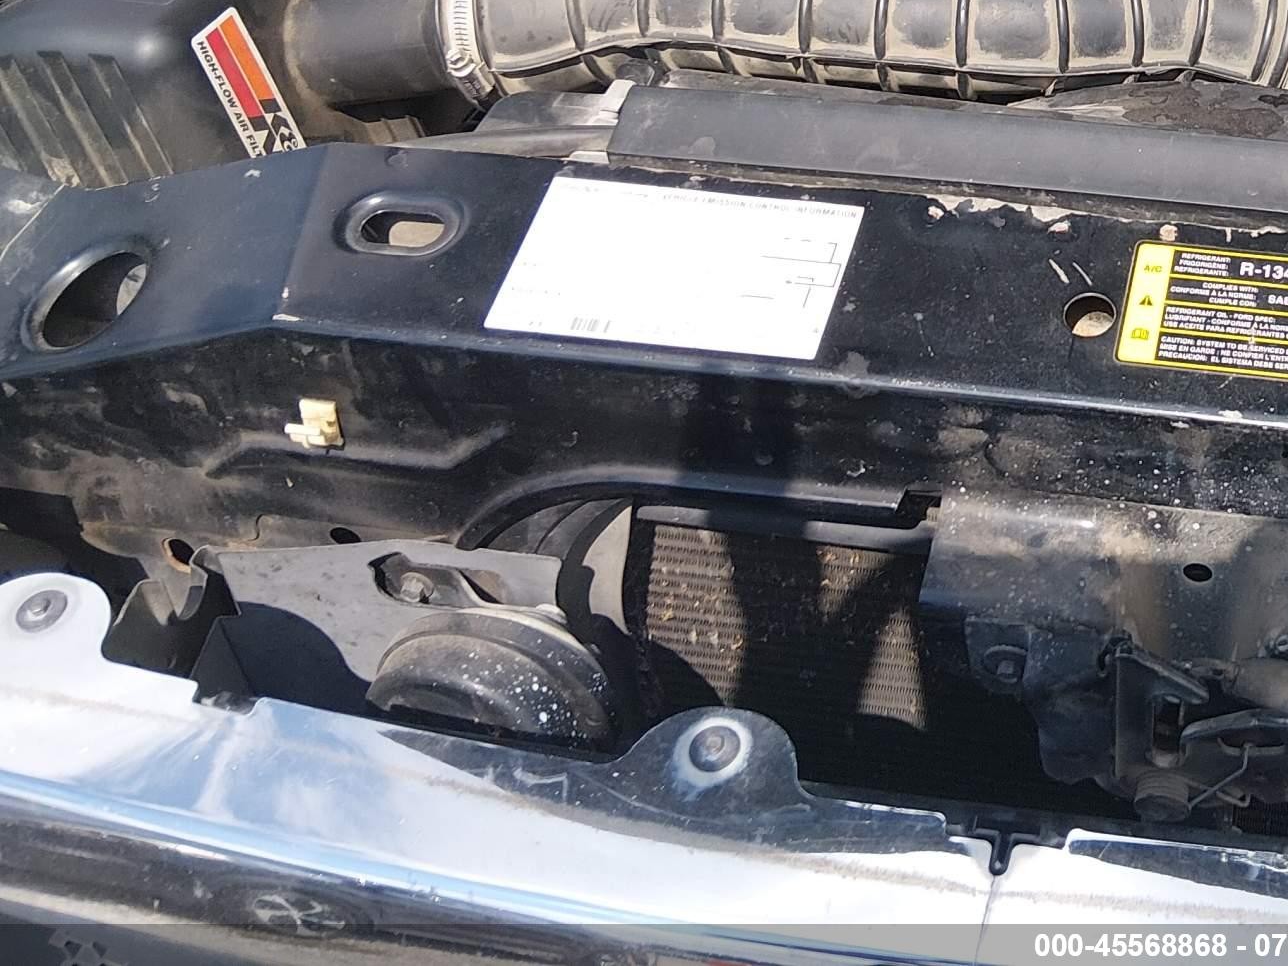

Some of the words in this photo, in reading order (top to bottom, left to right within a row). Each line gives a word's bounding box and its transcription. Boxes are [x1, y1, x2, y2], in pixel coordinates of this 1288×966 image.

[197, 41, 237, 109] HIGH-FLOW
[234, 110, 250, 132] AIR
[1143, 264, 1162, 272] A/C
[1170, 285, 1209, 295] CONFORME
[1202, 281, 1238, 291] COMPLIES
[1208, 297, 1236, 305] CUMPLE
[1165, 306, 1215, 316] REFRIGERANT
[1234, 313, 1253, 321] FORD
[1210, 317, 1250, 327] CONFORME
[1205, 324, 1225, 332] PARA
[1160, 336, 1195, 345] CAUTION:
[1195, 339, 1225, 348] SYSTEM
[1248, 345, 1284, 354] SERVICED
[1189, 346, 1215, 354] GARDE
[1231, 350, 1263, 359] CONFIER
[1210, 355, 1220, 363] EL
[1221, 356, 1252, 367] SISTEMA
[1253, 360, 1273, 369] DEBE
[1273, 362, 1288, 371] SER
